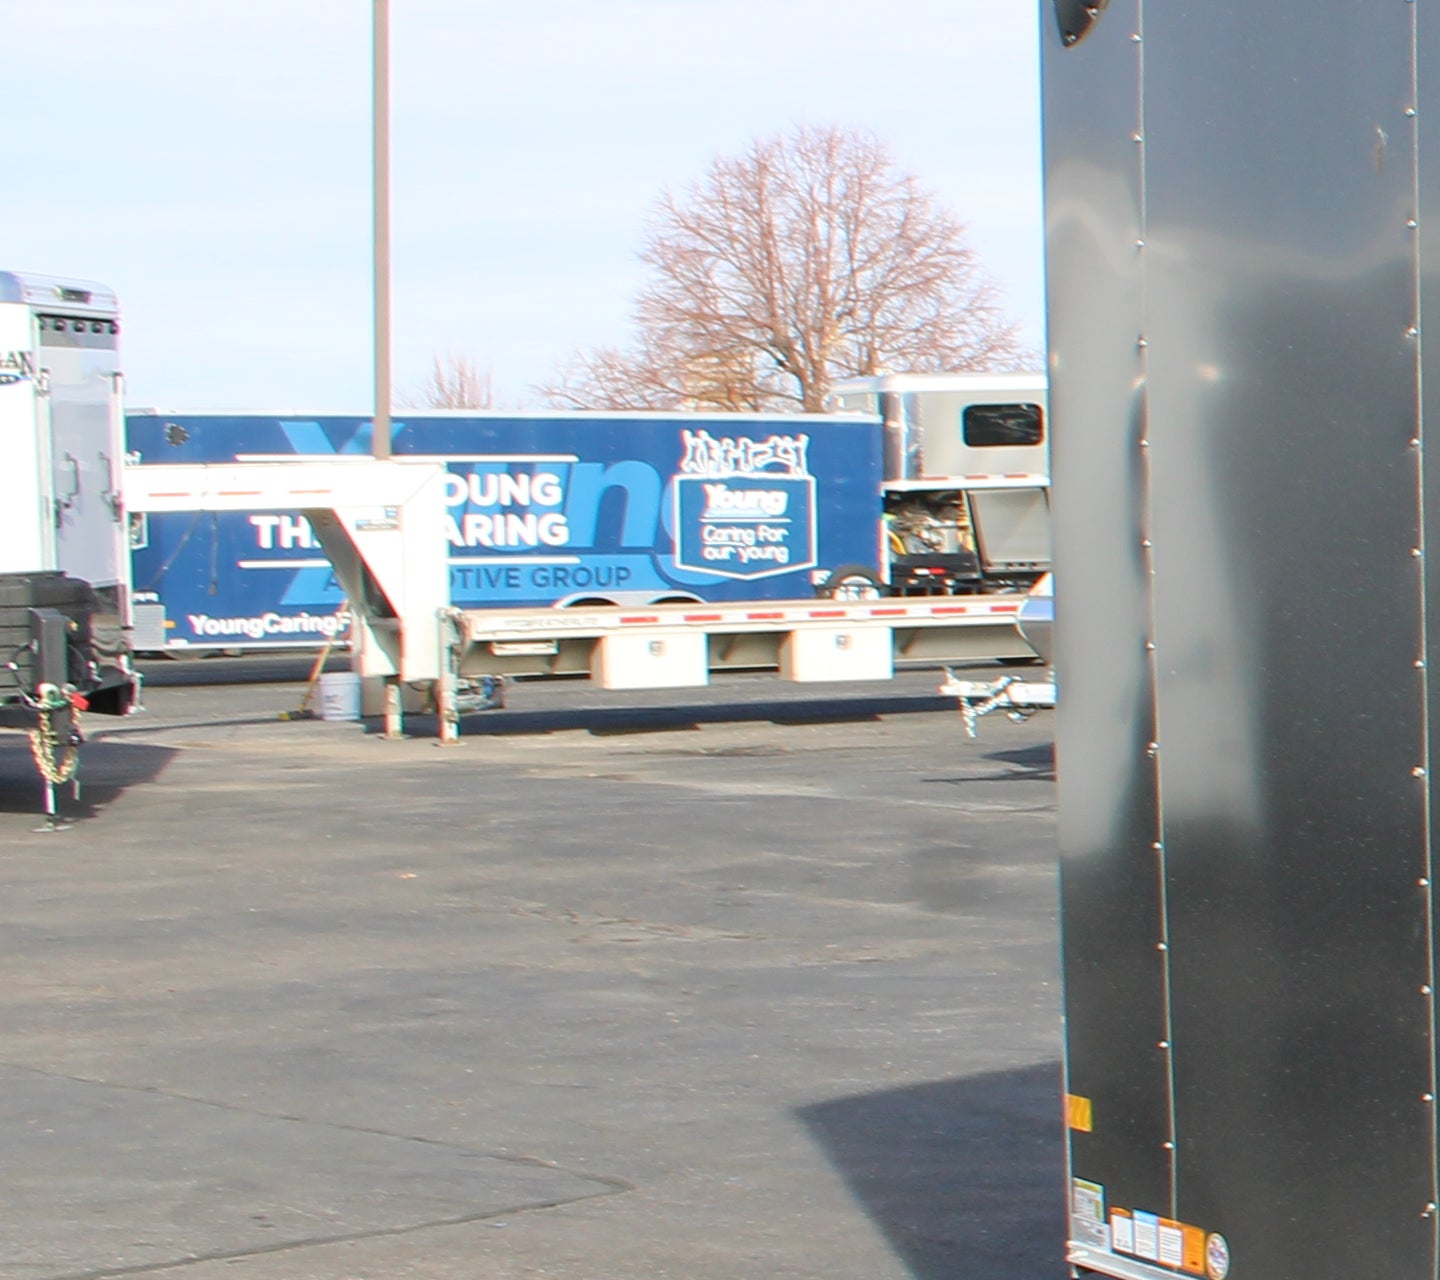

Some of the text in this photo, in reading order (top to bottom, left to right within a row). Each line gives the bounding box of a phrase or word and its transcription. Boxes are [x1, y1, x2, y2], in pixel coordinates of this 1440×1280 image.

[0, 350, 34, 375] AN
[445, 473, 562, 507] OUNG
[703, 483, 788, 515] Young
[702, 525, 755, 546] Caring
[702, 546, 789, 564] our young
[532, 566, 631, 588] GROUP
